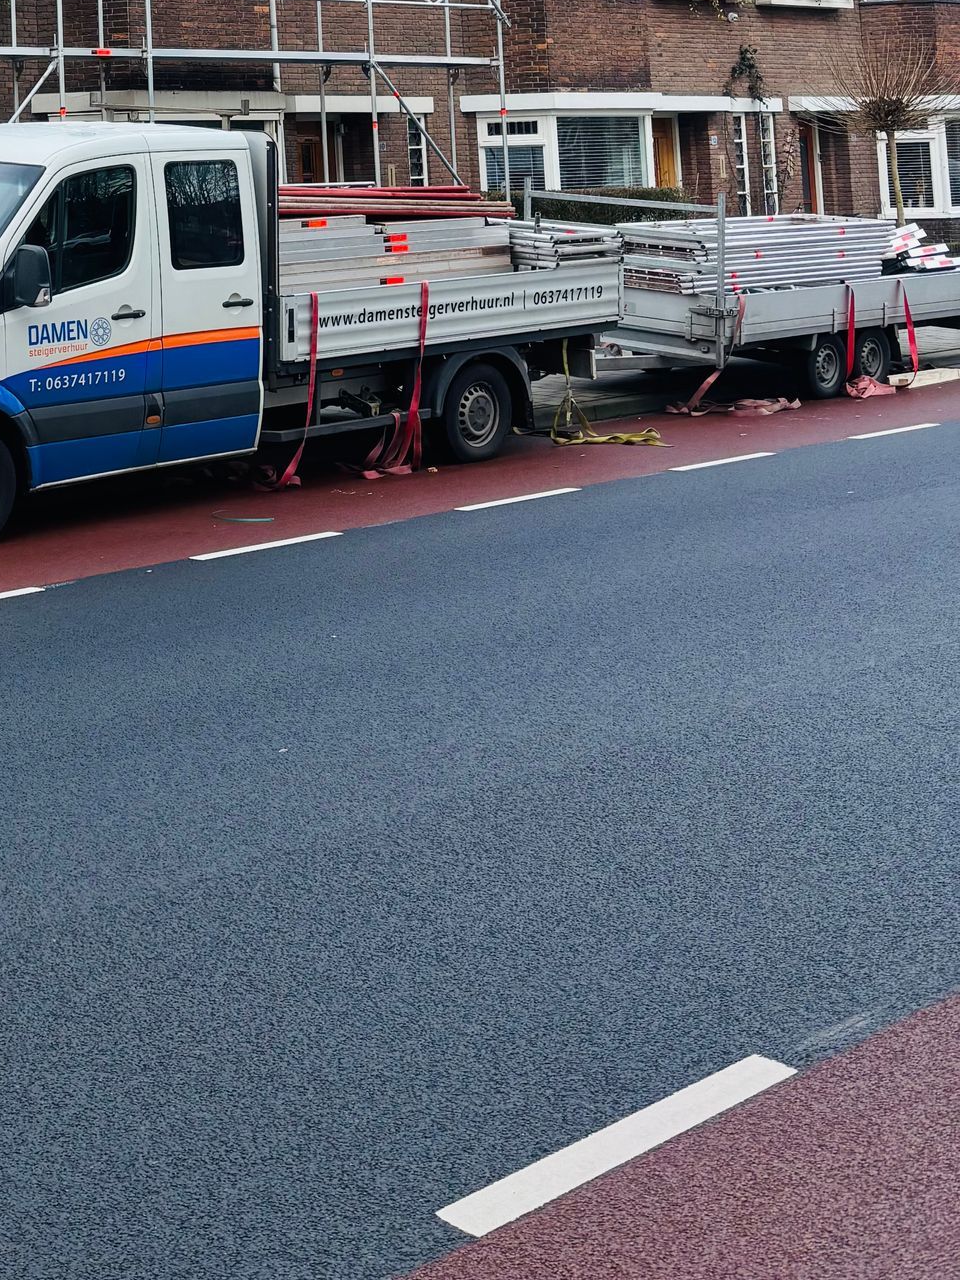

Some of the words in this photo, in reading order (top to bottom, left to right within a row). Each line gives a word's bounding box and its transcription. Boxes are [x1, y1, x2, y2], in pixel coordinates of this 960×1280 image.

[319, 292, 515, 328] www.damenstegerverhuur.nl
[533, 285, 603, 305] 0637417119
[28, 319, 89, 346] DAMEN
[29, 342, 88, 357] steigerverhuur
[29, 379, 42, 392] T:
[45, 369, 126, 390] 0637417119
